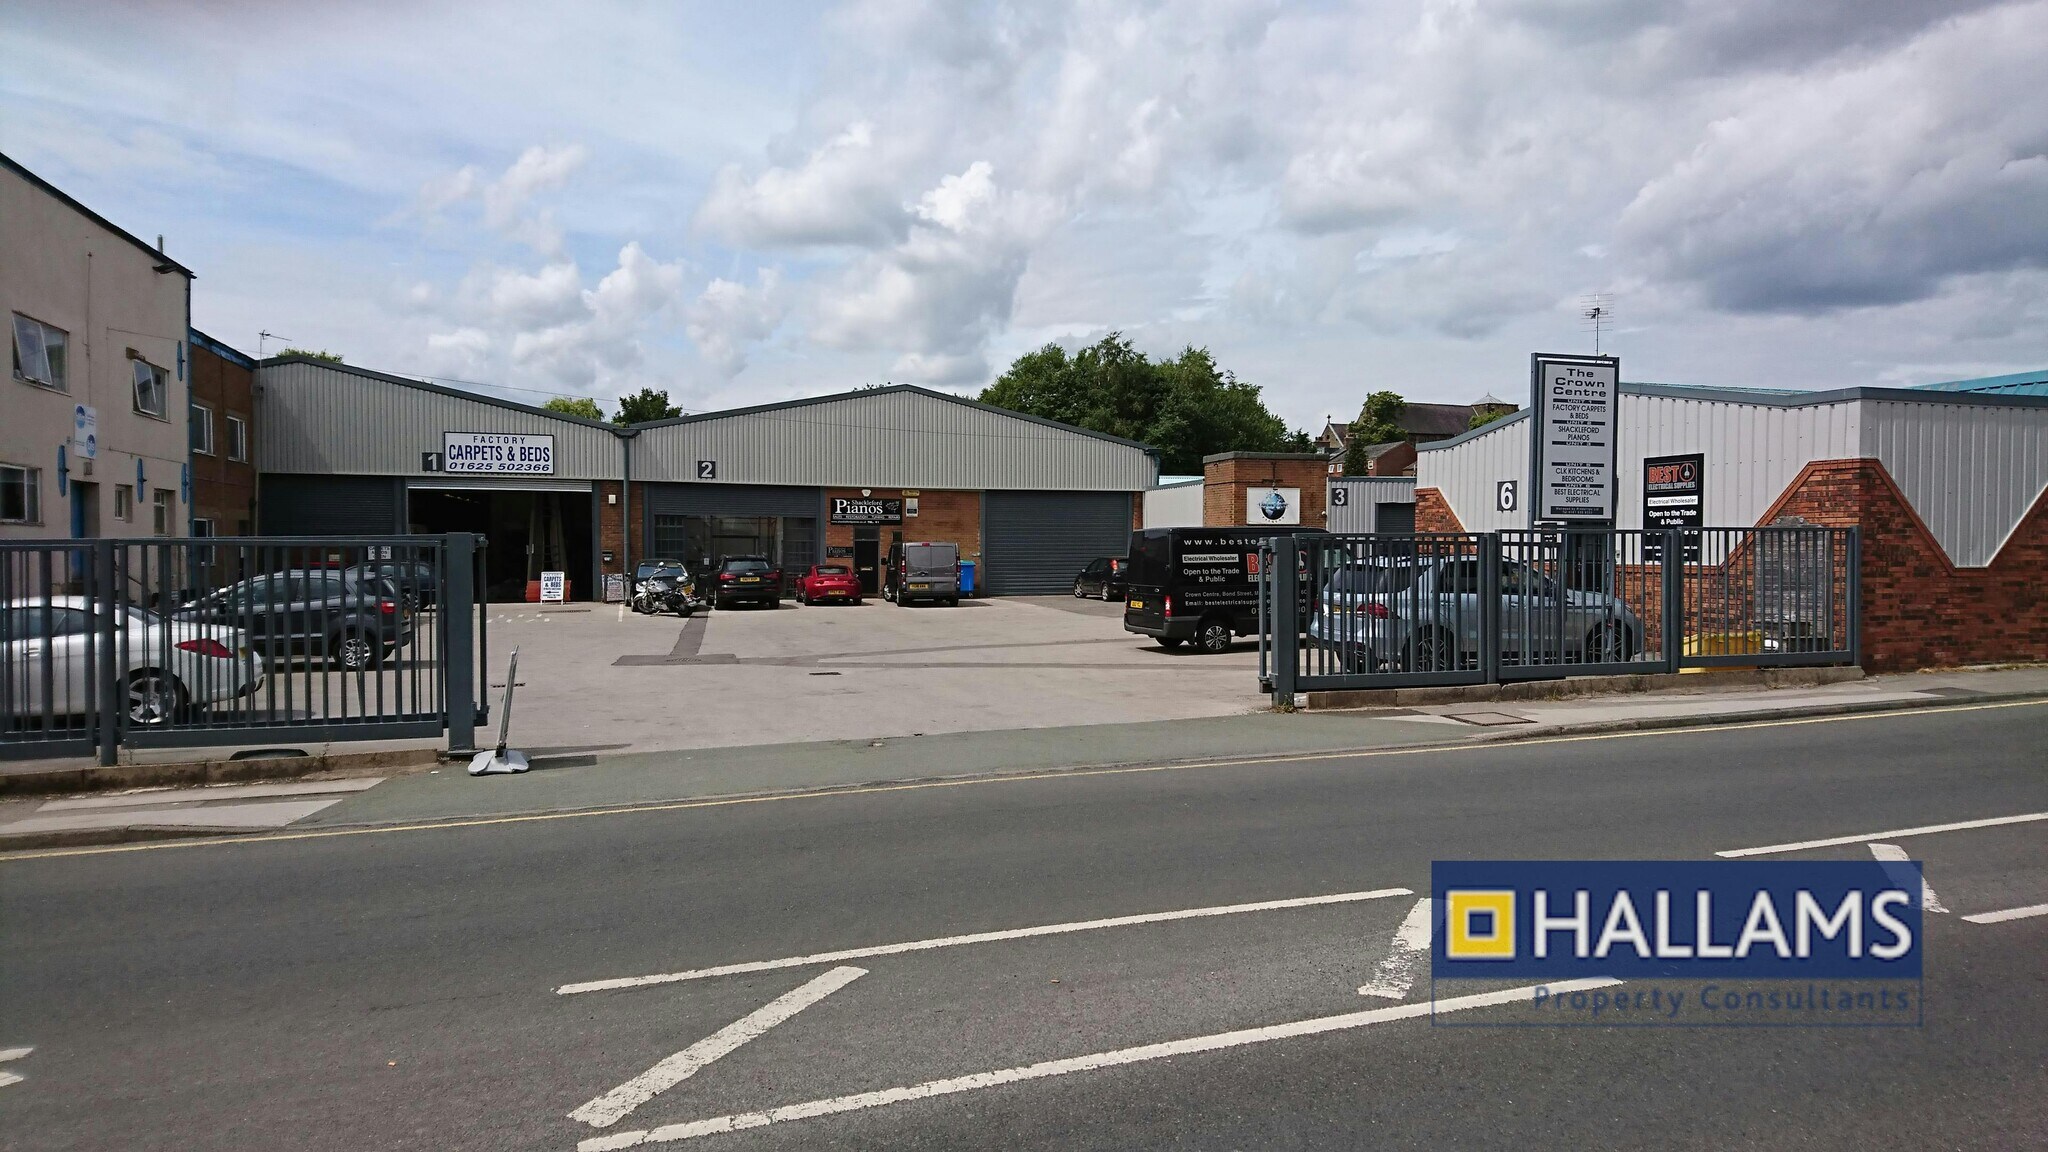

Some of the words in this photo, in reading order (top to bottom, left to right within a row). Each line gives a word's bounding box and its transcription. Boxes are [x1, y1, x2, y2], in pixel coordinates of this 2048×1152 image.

[1567, 368, 1594, 377] The
[1555, 377, 1605, 387] Crown
[1553, 387, 1606, 397] Centre
[474, 436, 526, 444] FACTORY
[449, 444, 502, 461] CARPETS
[507, 446, 515, 461] &
[520, 446, 550, 462] BEDS
[428, 454, 437, 470] 1
[449, 462, 493, 470] 01625
[498, 463, 550, 471] 502366
[701, 462, 712, 477] 2
[1648, 466, 1679, 484] BEST
[1648, 482, 1674, 490] ELECTRICAL
[1334, 488, 1345, 505] 3
[1500, 483, 1514, 510] 6
[835, 499, 883, 514] Pianos
